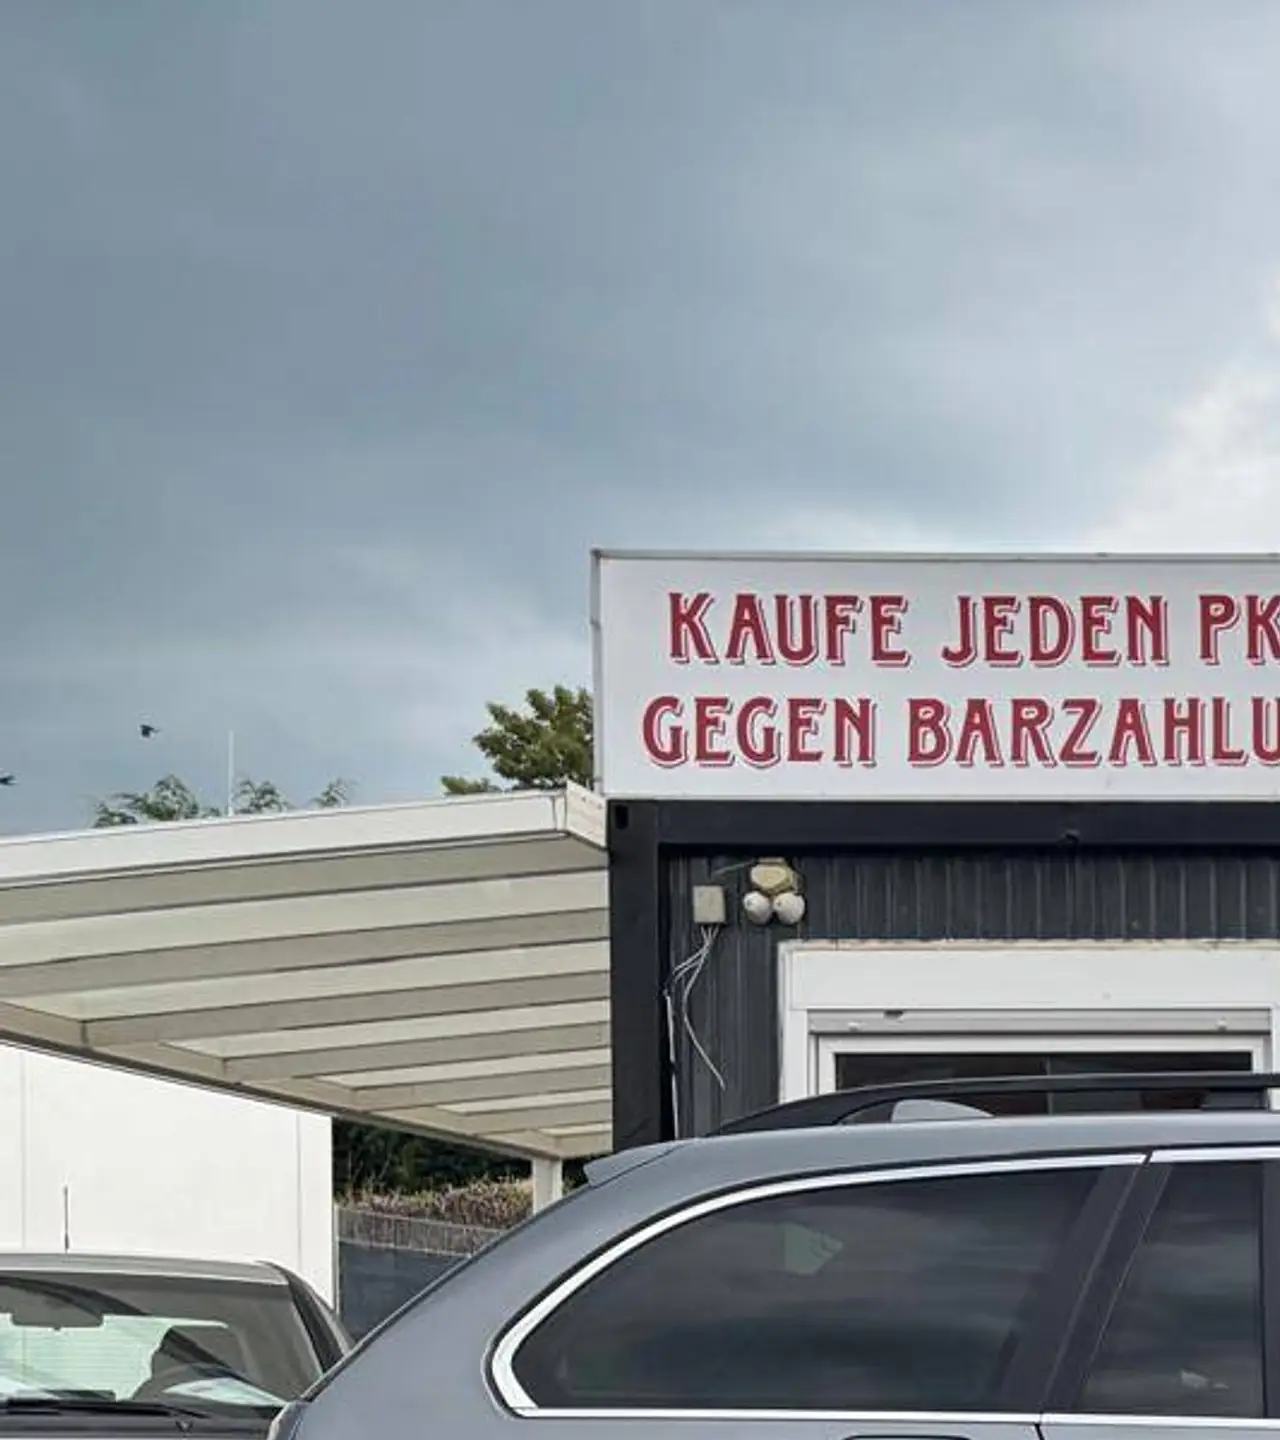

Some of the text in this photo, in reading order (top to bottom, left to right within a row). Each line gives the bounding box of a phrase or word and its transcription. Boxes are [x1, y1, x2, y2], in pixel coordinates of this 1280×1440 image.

[668, 592, 909, 666] KAUFE
[942, 593, 1169, 667] JEDEN
[642, 695, 878, 767] GEGEN
